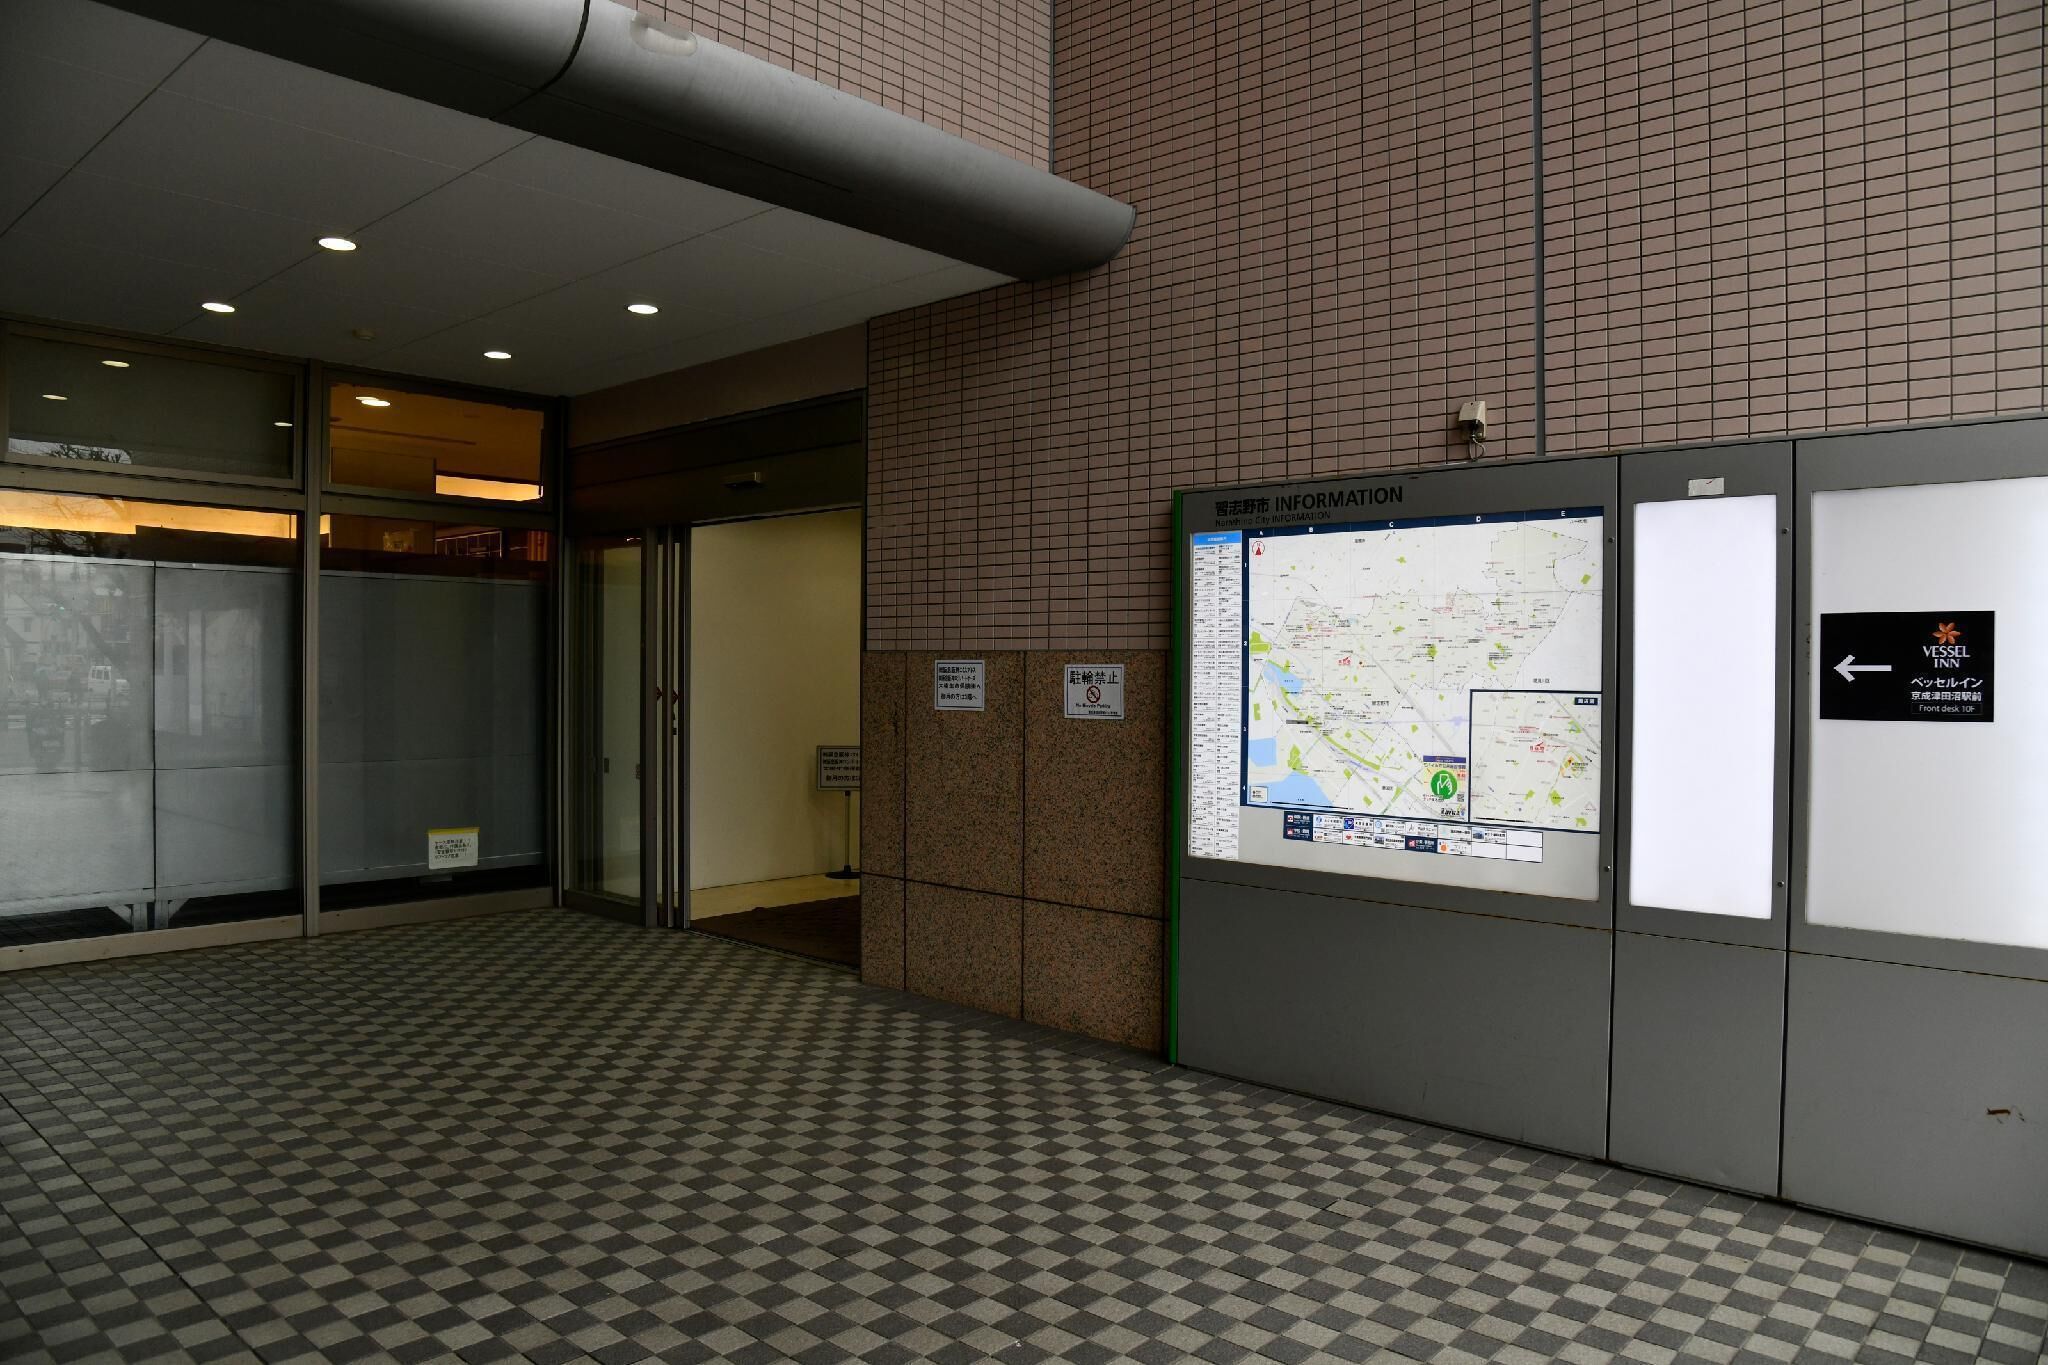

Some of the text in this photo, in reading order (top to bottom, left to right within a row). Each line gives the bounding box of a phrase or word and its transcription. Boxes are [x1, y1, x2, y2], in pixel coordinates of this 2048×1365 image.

[1215, 487, 1403, 517] 習志野市 INFORMATION
[1255, 515, 1270, 526] City
[1272, 511, 1331, 523] INFORMATION
[1922, 645, 1971, 658] VESSEL
[1934, 658, 1961, 668] INN
[1069, 670, 1119, 685] 駐輪禁止
[1910, 677, 1983, 688] ベッセルイン
[1911, 691, 1982, 701] 京成津田沼駅前
[1919, 704, 1940, 712] Front
[1941, 704, 1959, 712] desk
